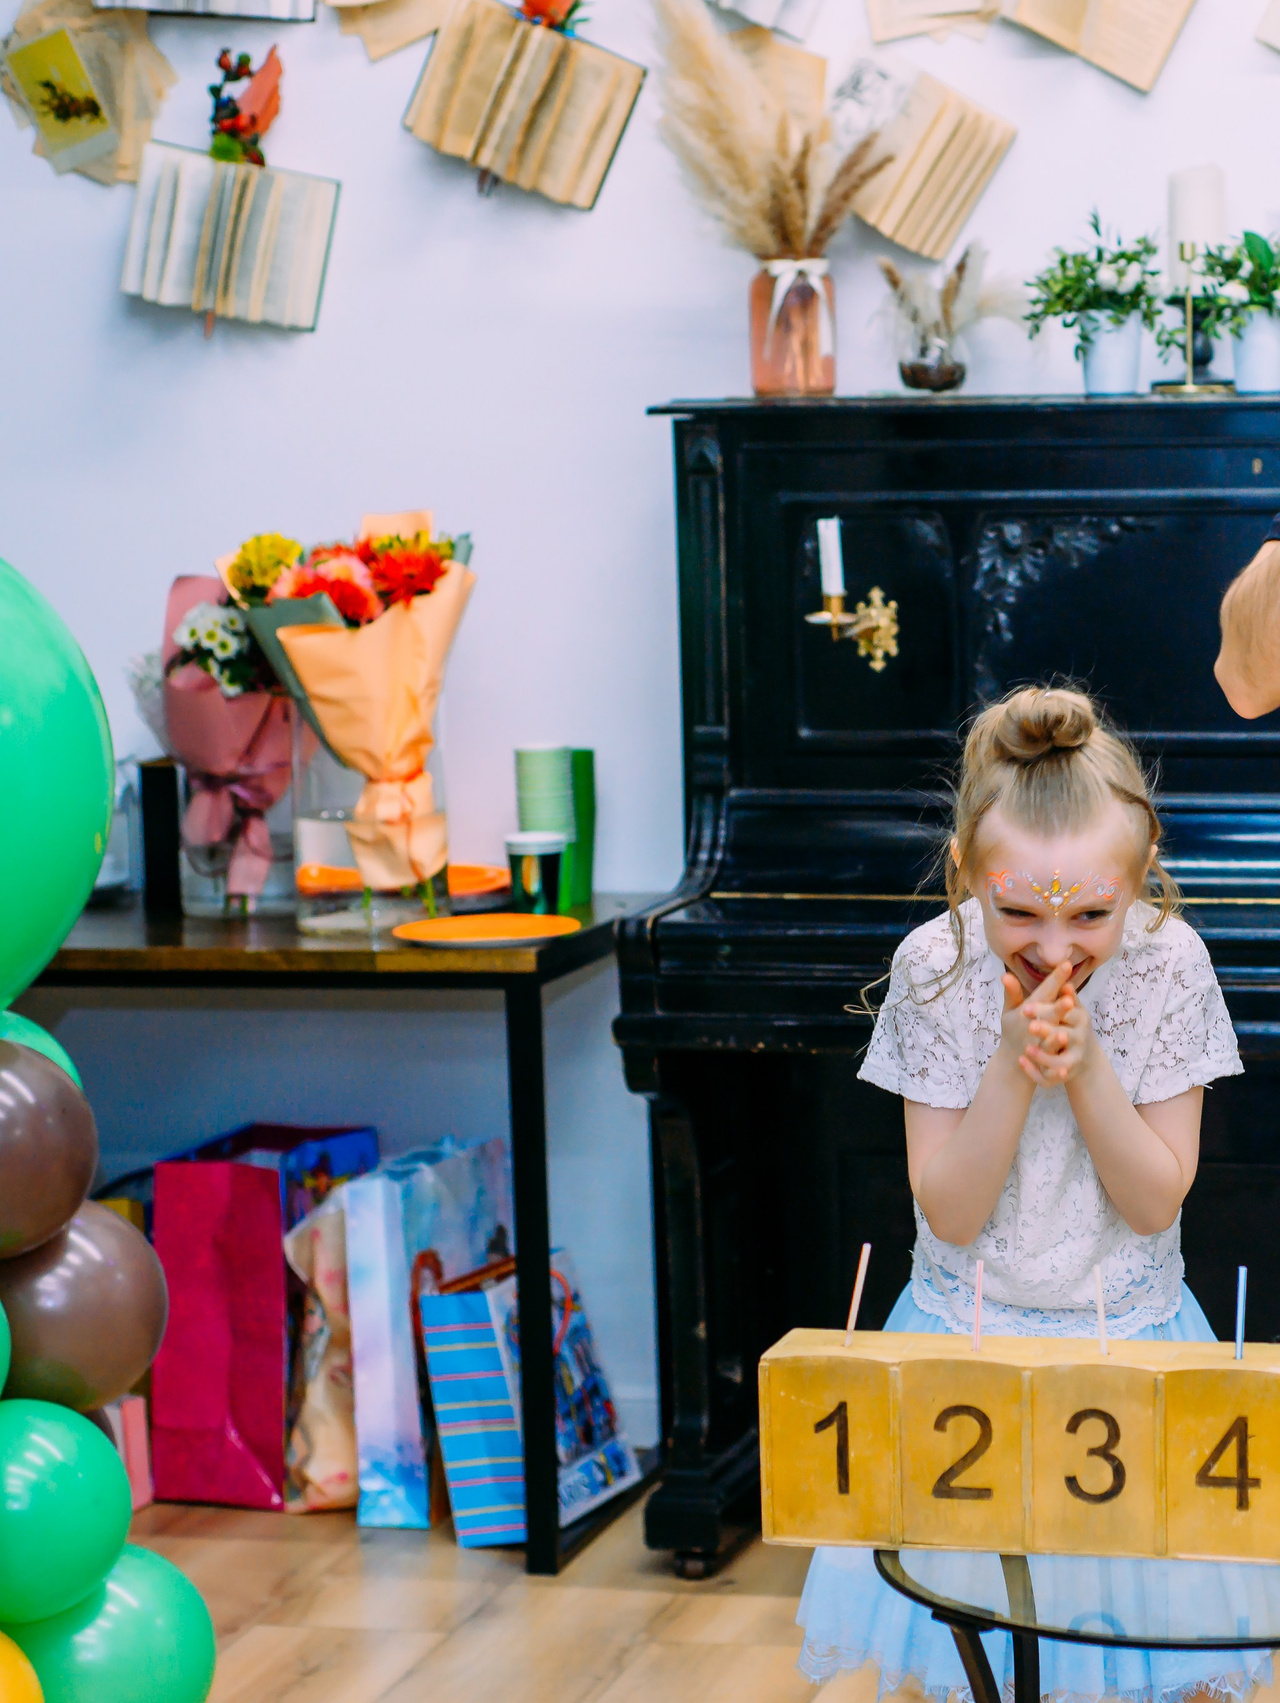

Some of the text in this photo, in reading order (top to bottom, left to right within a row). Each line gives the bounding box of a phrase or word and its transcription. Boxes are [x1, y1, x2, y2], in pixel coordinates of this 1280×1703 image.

[813, 1401, 849, 1495] 1
[932, 1404, 993, 1500] 2
[1064, 1408, 1126, 1505] 3
[1195, 1415, 1261, 1512] 4
